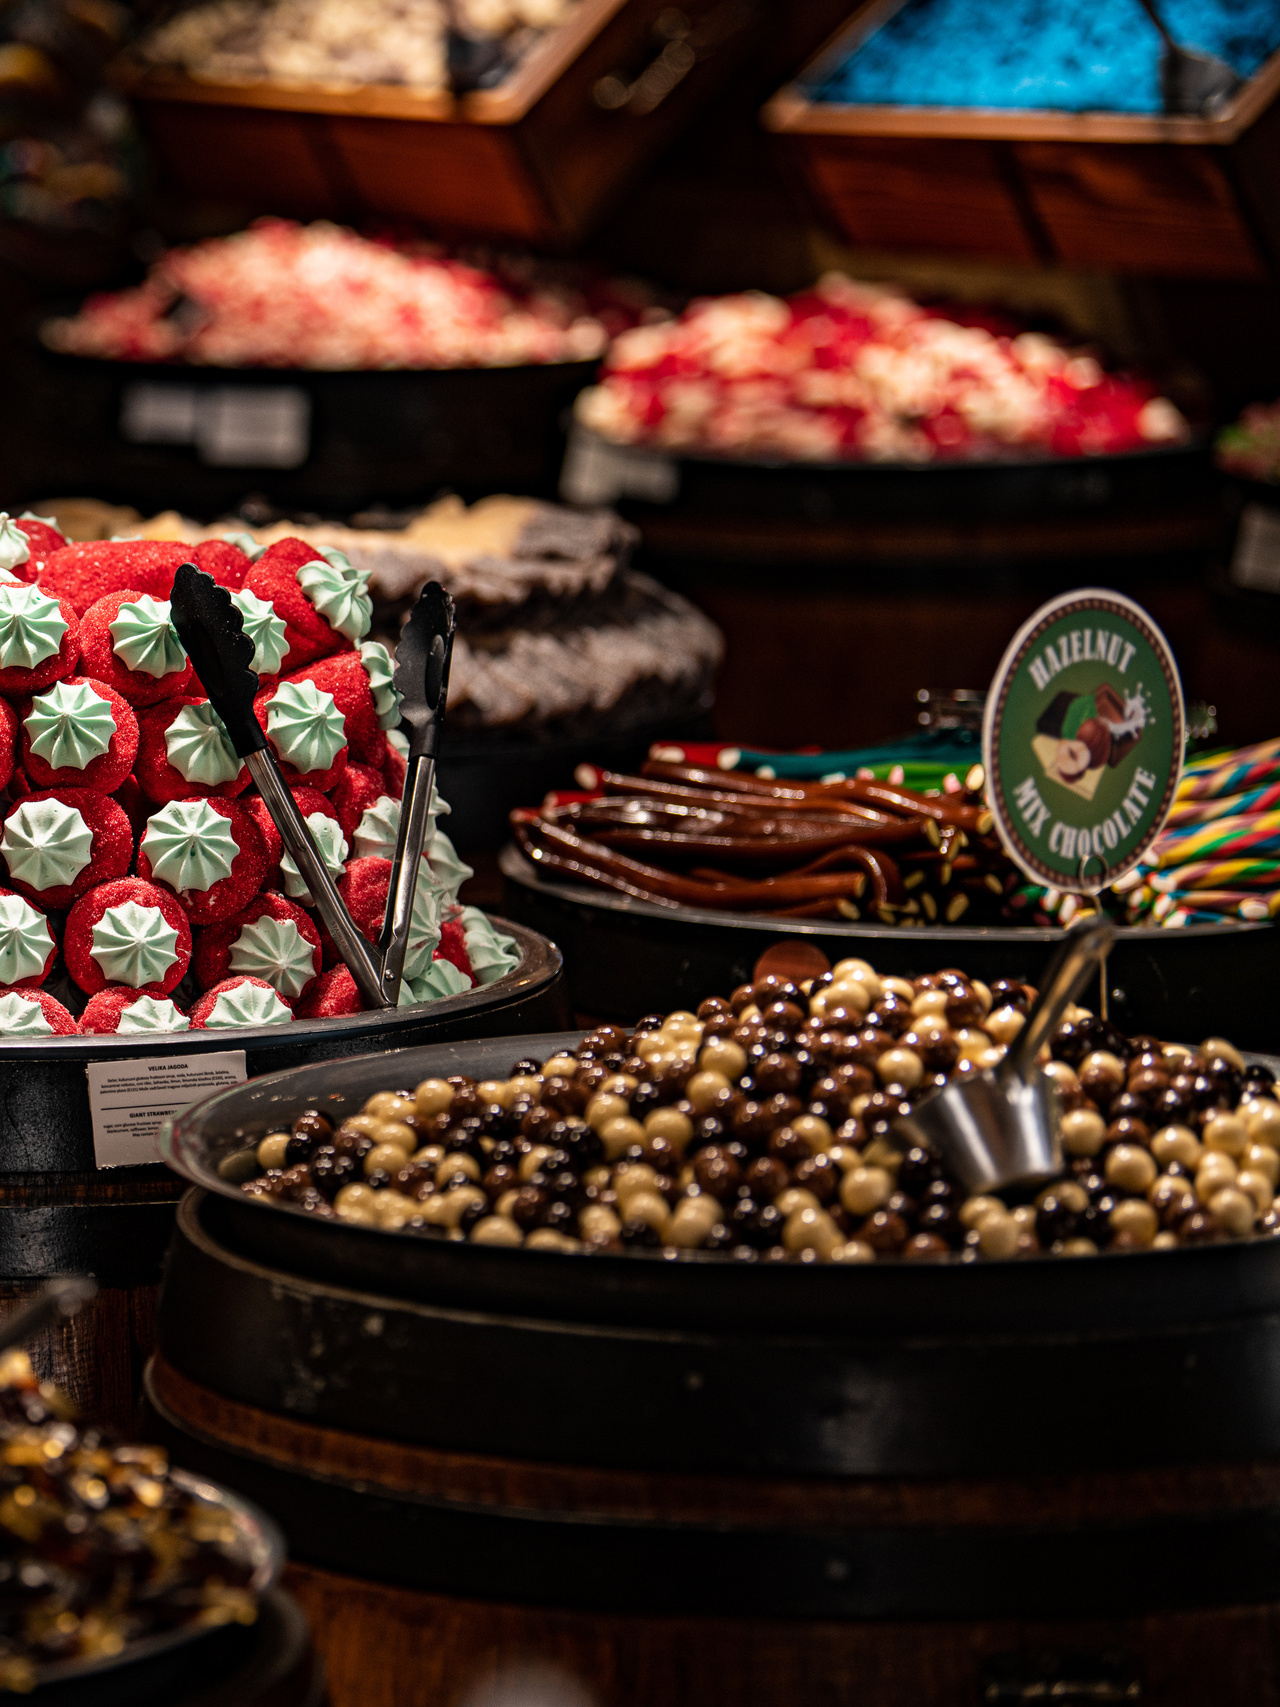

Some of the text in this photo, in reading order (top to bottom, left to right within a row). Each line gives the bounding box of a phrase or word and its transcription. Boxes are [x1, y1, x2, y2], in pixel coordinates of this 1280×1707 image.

[1028, 629, 1136, 690] HAZELNUT
[1014, 768, 1157, 859] MIX CHOCOLATE
